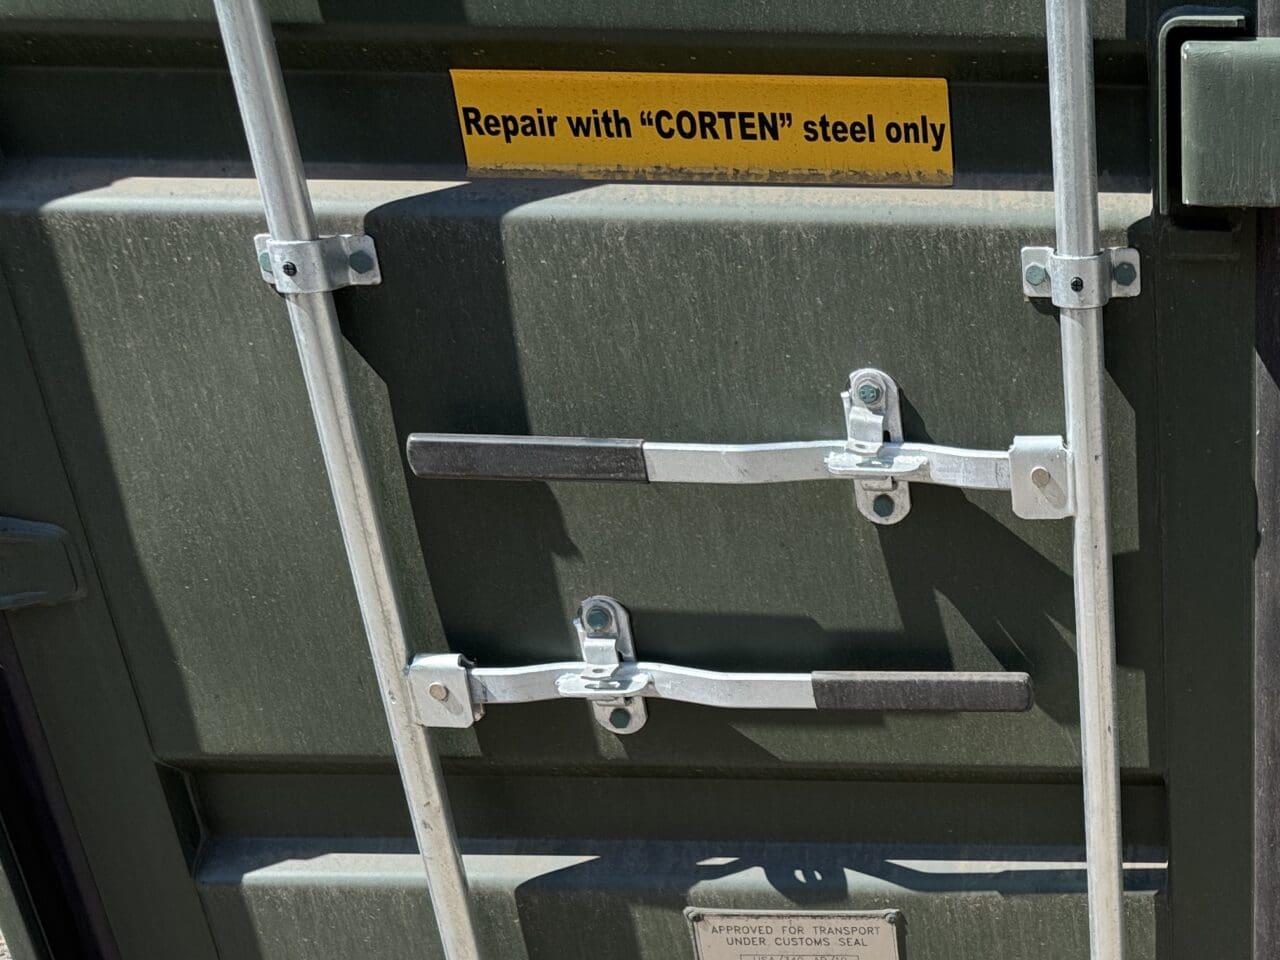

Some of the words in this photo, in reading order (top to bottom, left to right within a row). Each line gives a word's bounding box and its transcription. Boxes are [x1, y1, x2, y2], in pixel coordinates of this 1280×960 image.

[462, 106, 559, 143] Repair
[567, 109, 633, 139] with
[640, 109, 793, 141] “CORTEN”
[803, 114, 876, 143] steel
[885, 115, 946, 152] only
[711, 926, 773, 935] APPROVED
[782, 926, 804, 935] FOR
[813, 926, 881, 936] TRANSPORT
[726, 937, 766, 946] UNDER
[774, 937, 830, 947] CUSTOMS
[839, 938, 868, 947] SEAL
